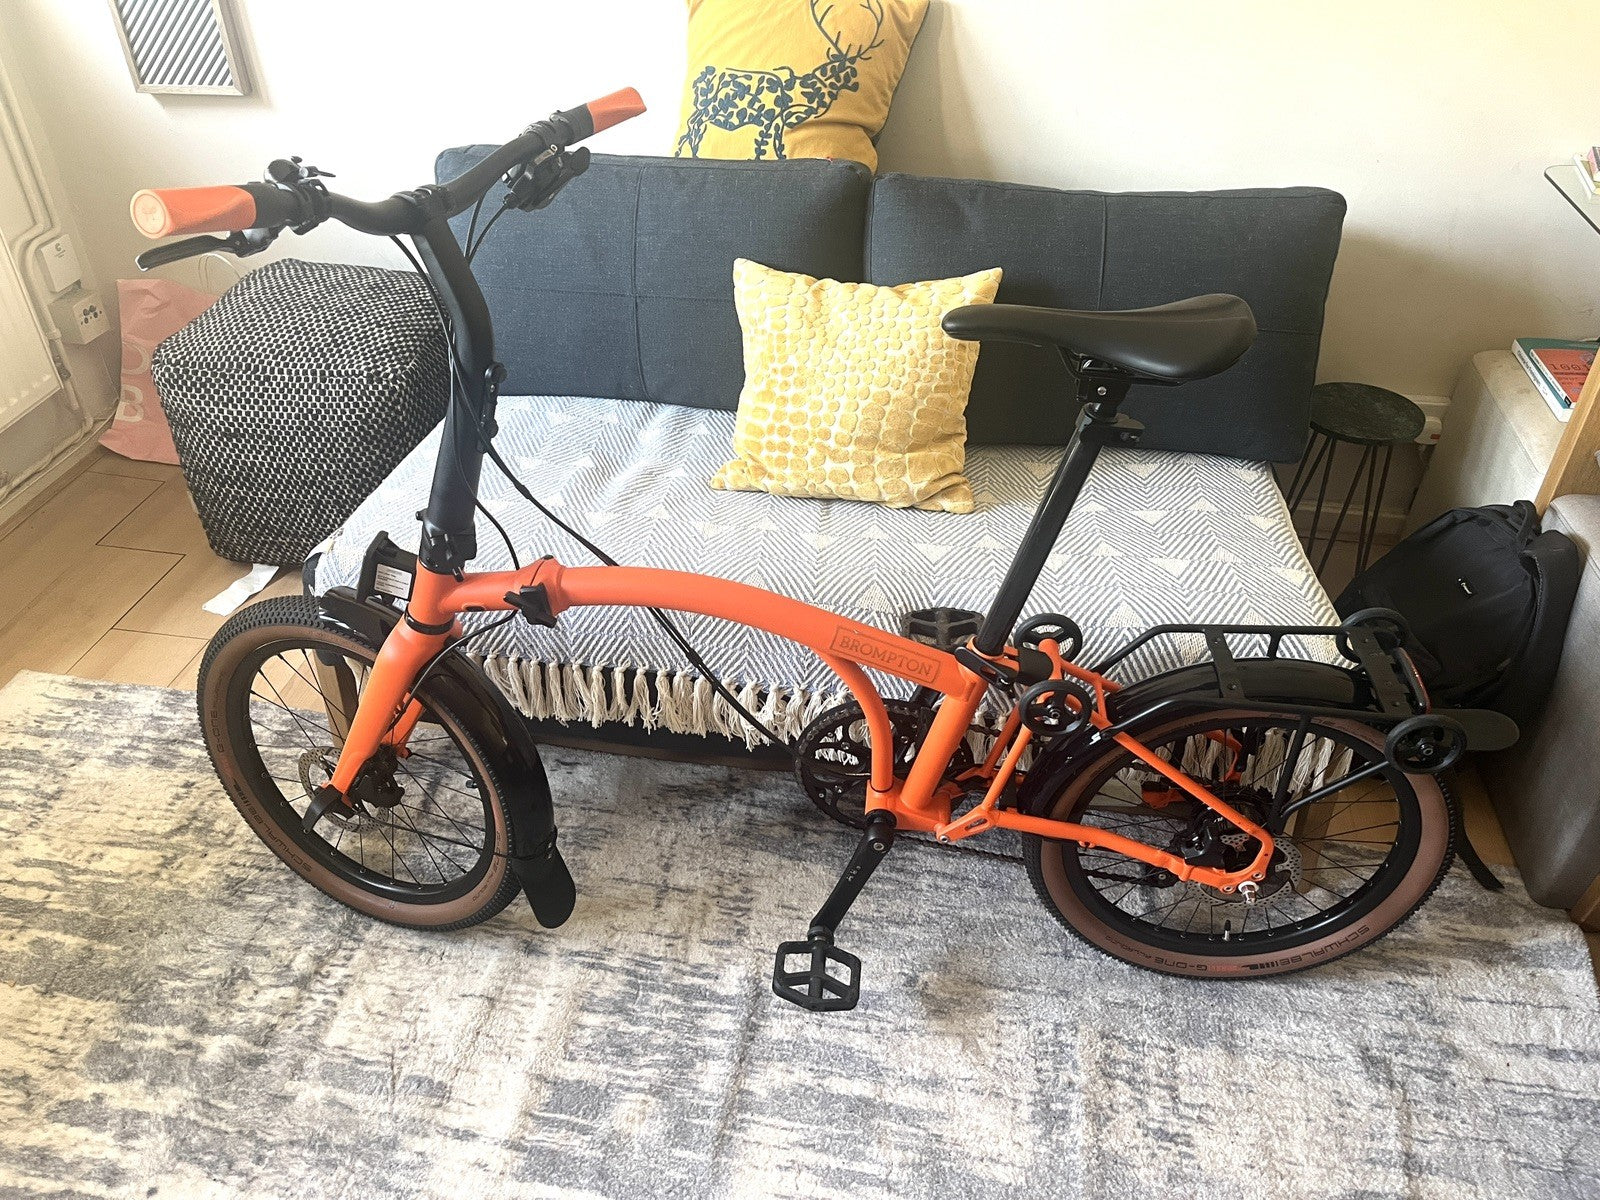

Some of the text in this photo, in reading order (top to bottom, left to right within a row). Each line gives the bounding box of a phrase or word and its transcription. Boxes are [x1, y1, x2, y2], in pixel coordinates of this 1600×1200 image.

[840, 635, 934, 676] BROMPTON
[250, 806, 313, 874] SCHWALBE
[1279, 924, 1371, 966] SCHWALBE
